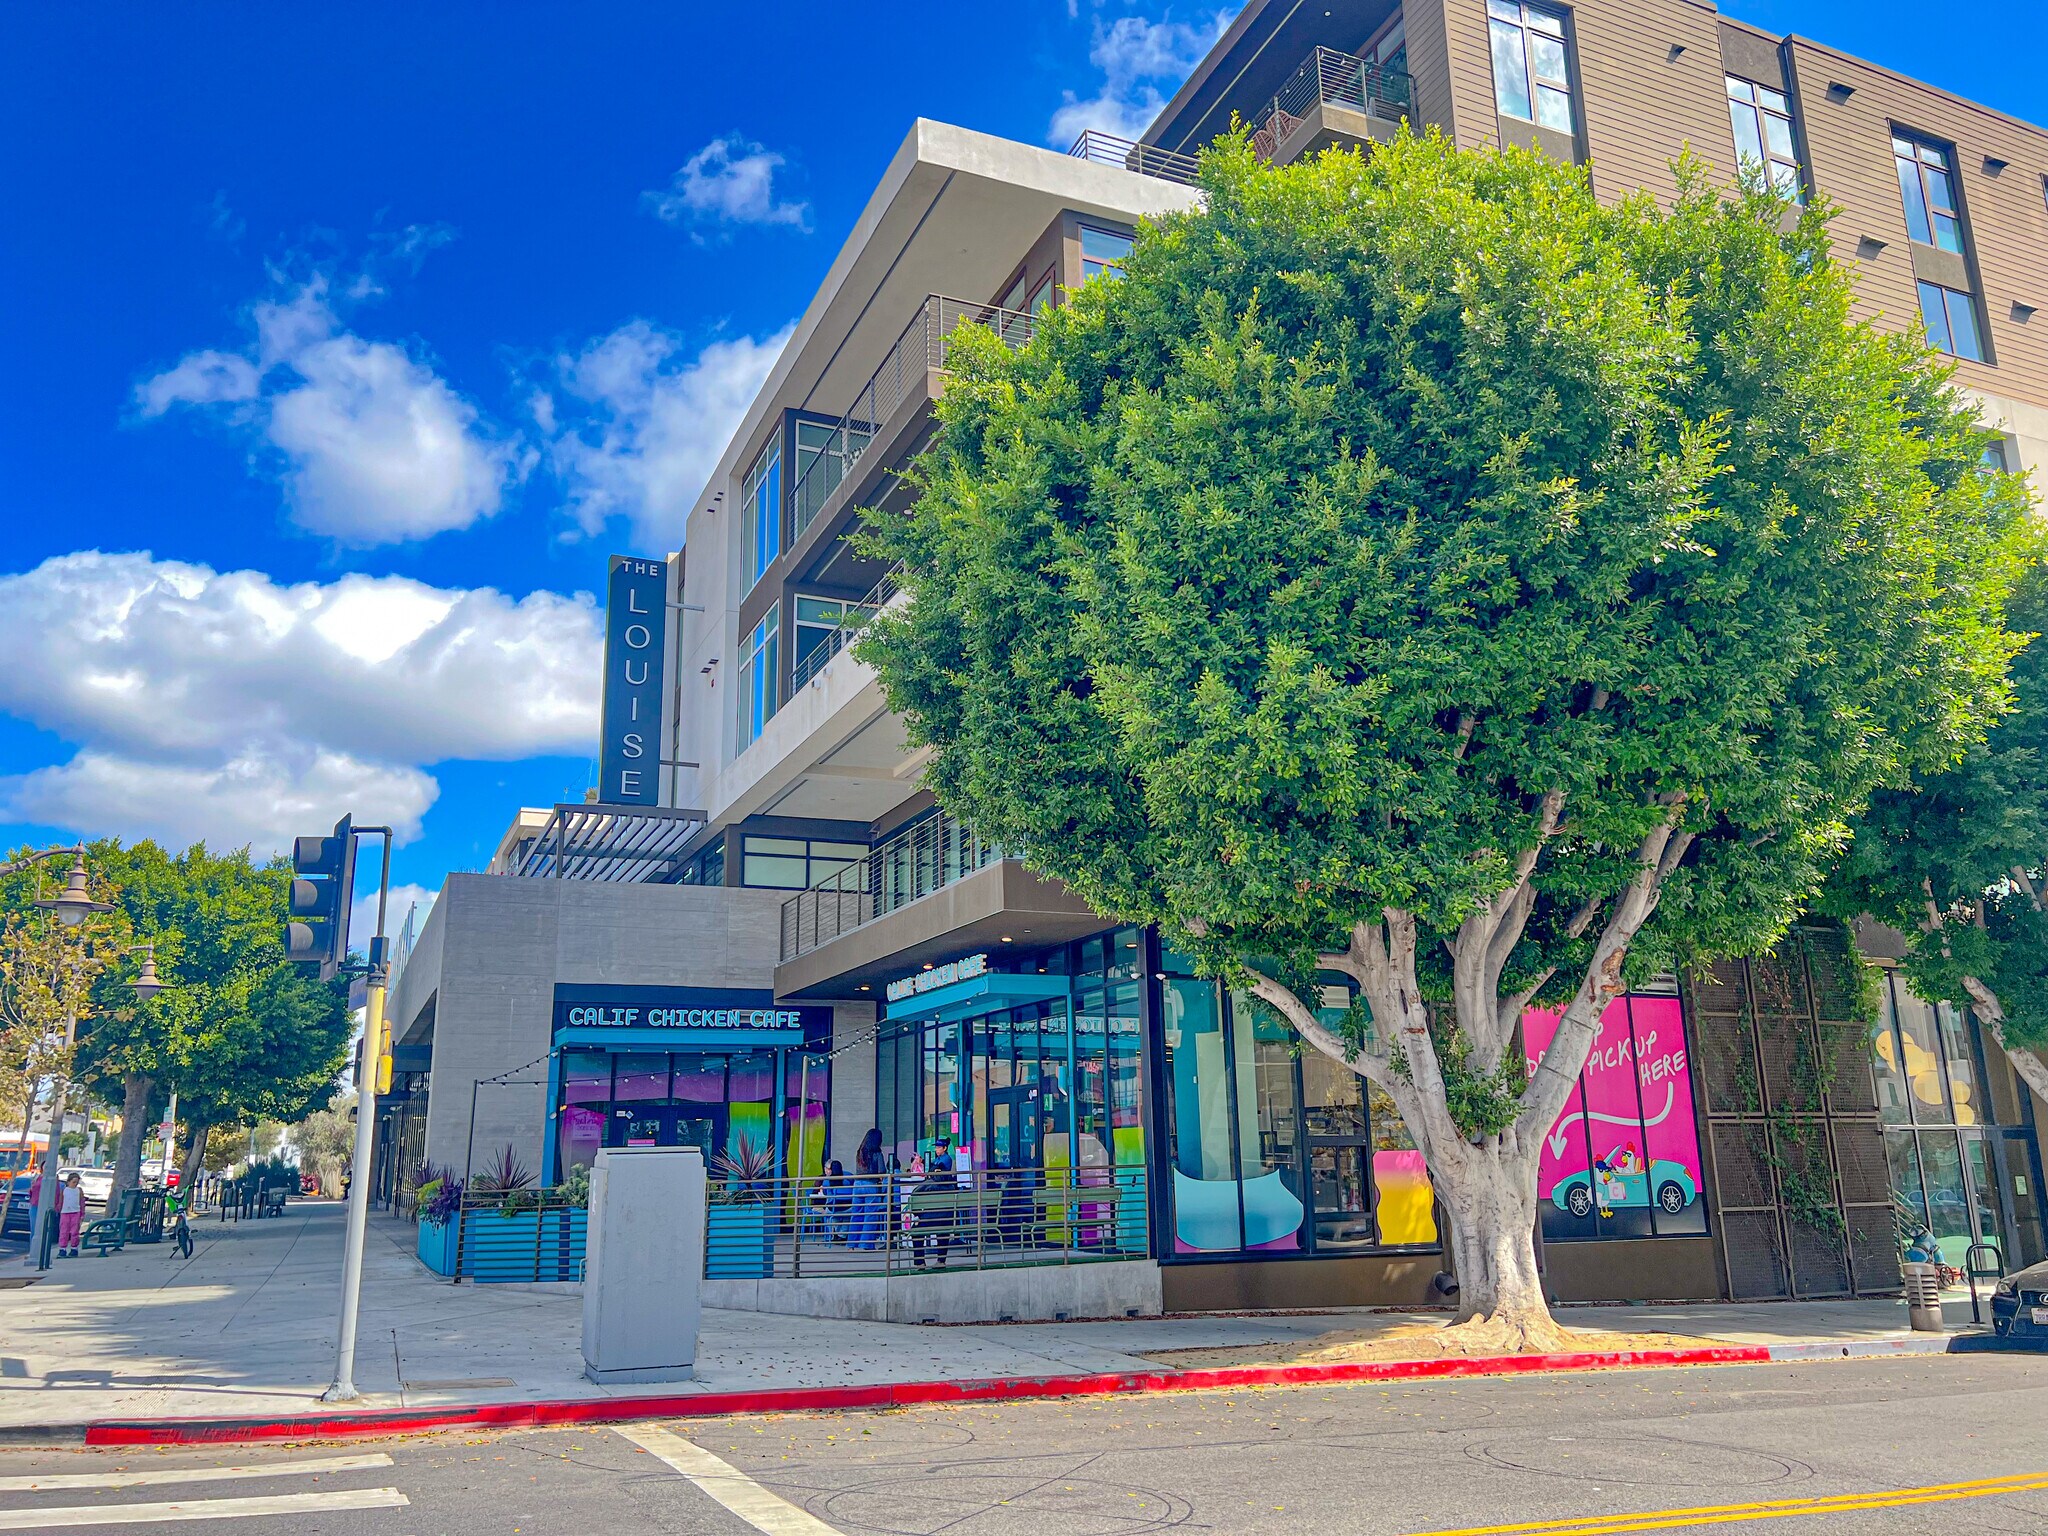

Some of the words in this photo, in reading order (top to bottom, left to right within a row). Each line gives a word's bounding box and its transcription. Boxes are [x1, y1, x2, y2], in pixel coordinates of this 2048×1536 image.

[622, 560, 658, 577] THE
[620, 588, 651, 796] LOUISE
[957, 954, 988, 980] CAFE
[569, 1007, 639, 1026] CALIF
[648, 1008, 740, 1027] CHICKEN
[750, 1010, 801, 1028] CAFE
[1588, 1030, 1657, 1076] PICKUP
[1640, 1050, 1685, 1087] HERE
[1612, 1186, 1619, 1198] C
